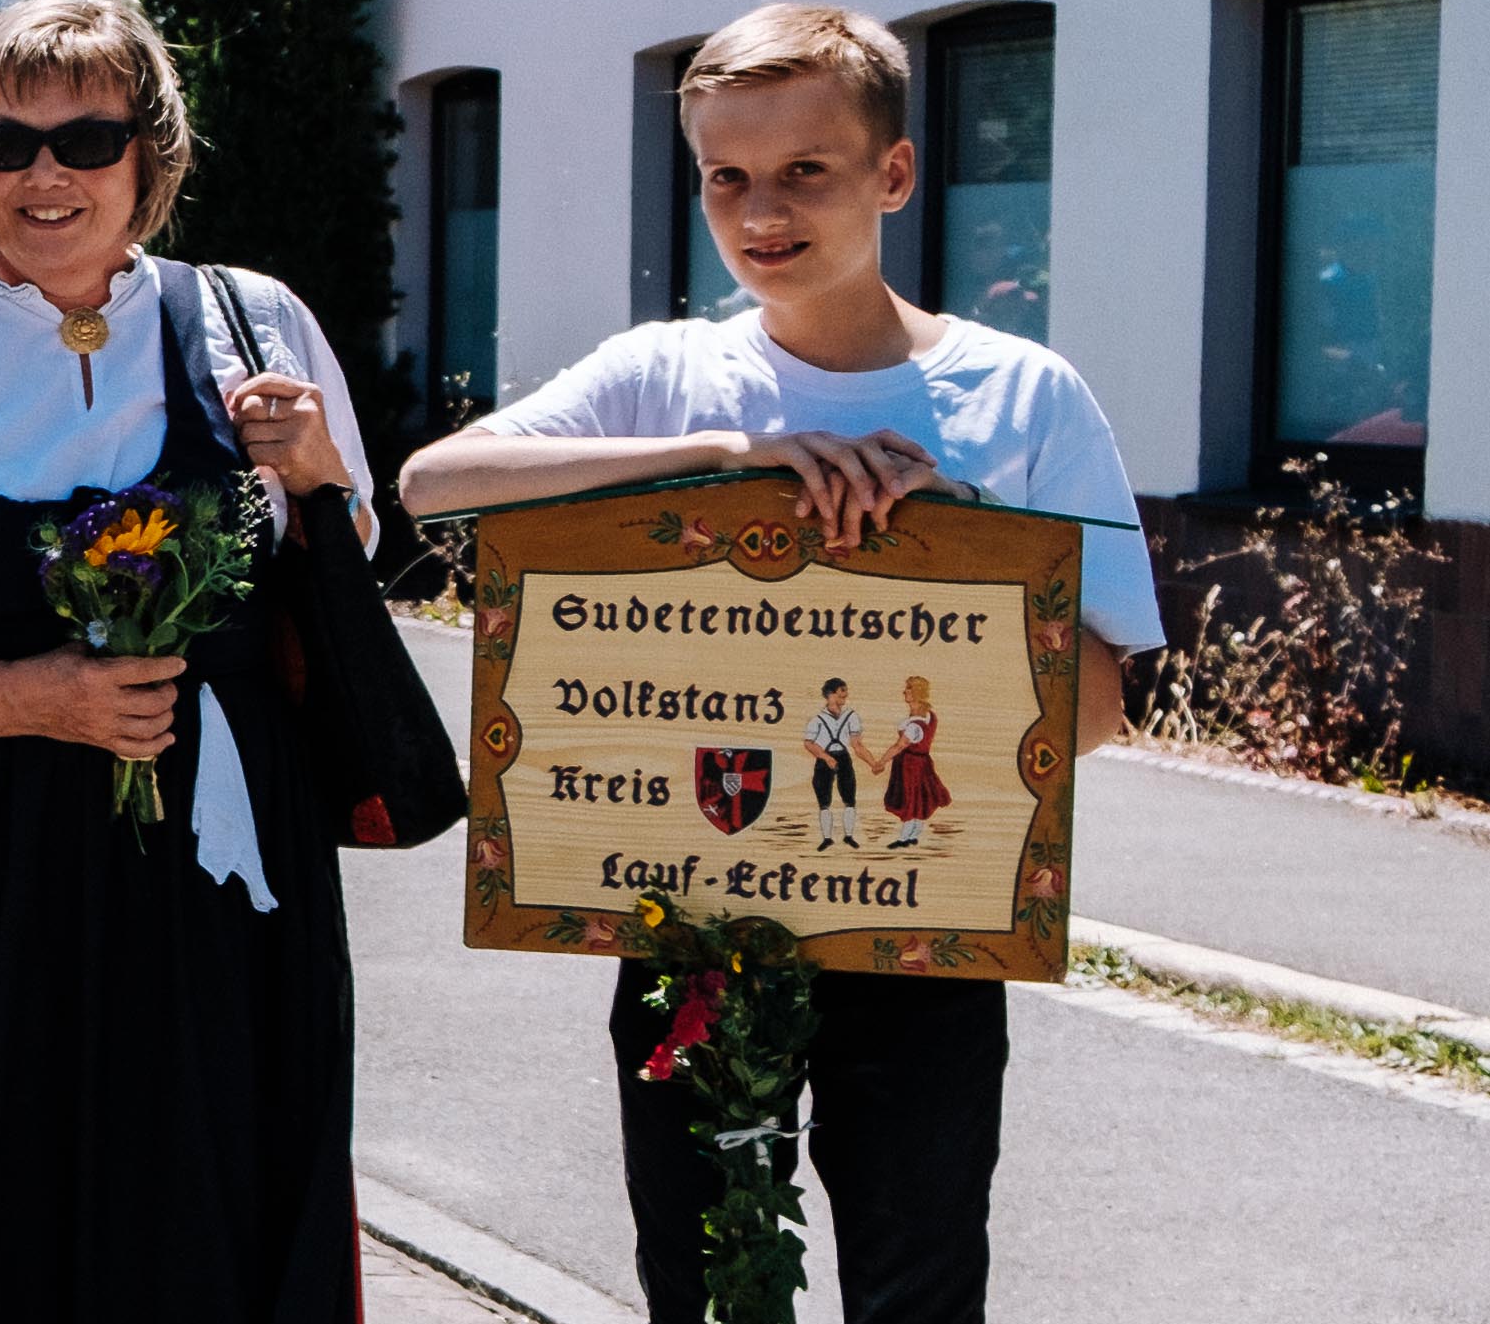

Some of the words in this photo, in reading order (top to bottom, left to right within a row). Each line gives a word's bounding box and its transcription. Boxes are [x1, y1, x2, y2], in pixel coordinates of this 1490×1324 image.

[551, 593, 989, 647] Sudetendeutscher
[553, 678, 785, 724] Volkstanz
[548, 765, 671, 805] Kreis
